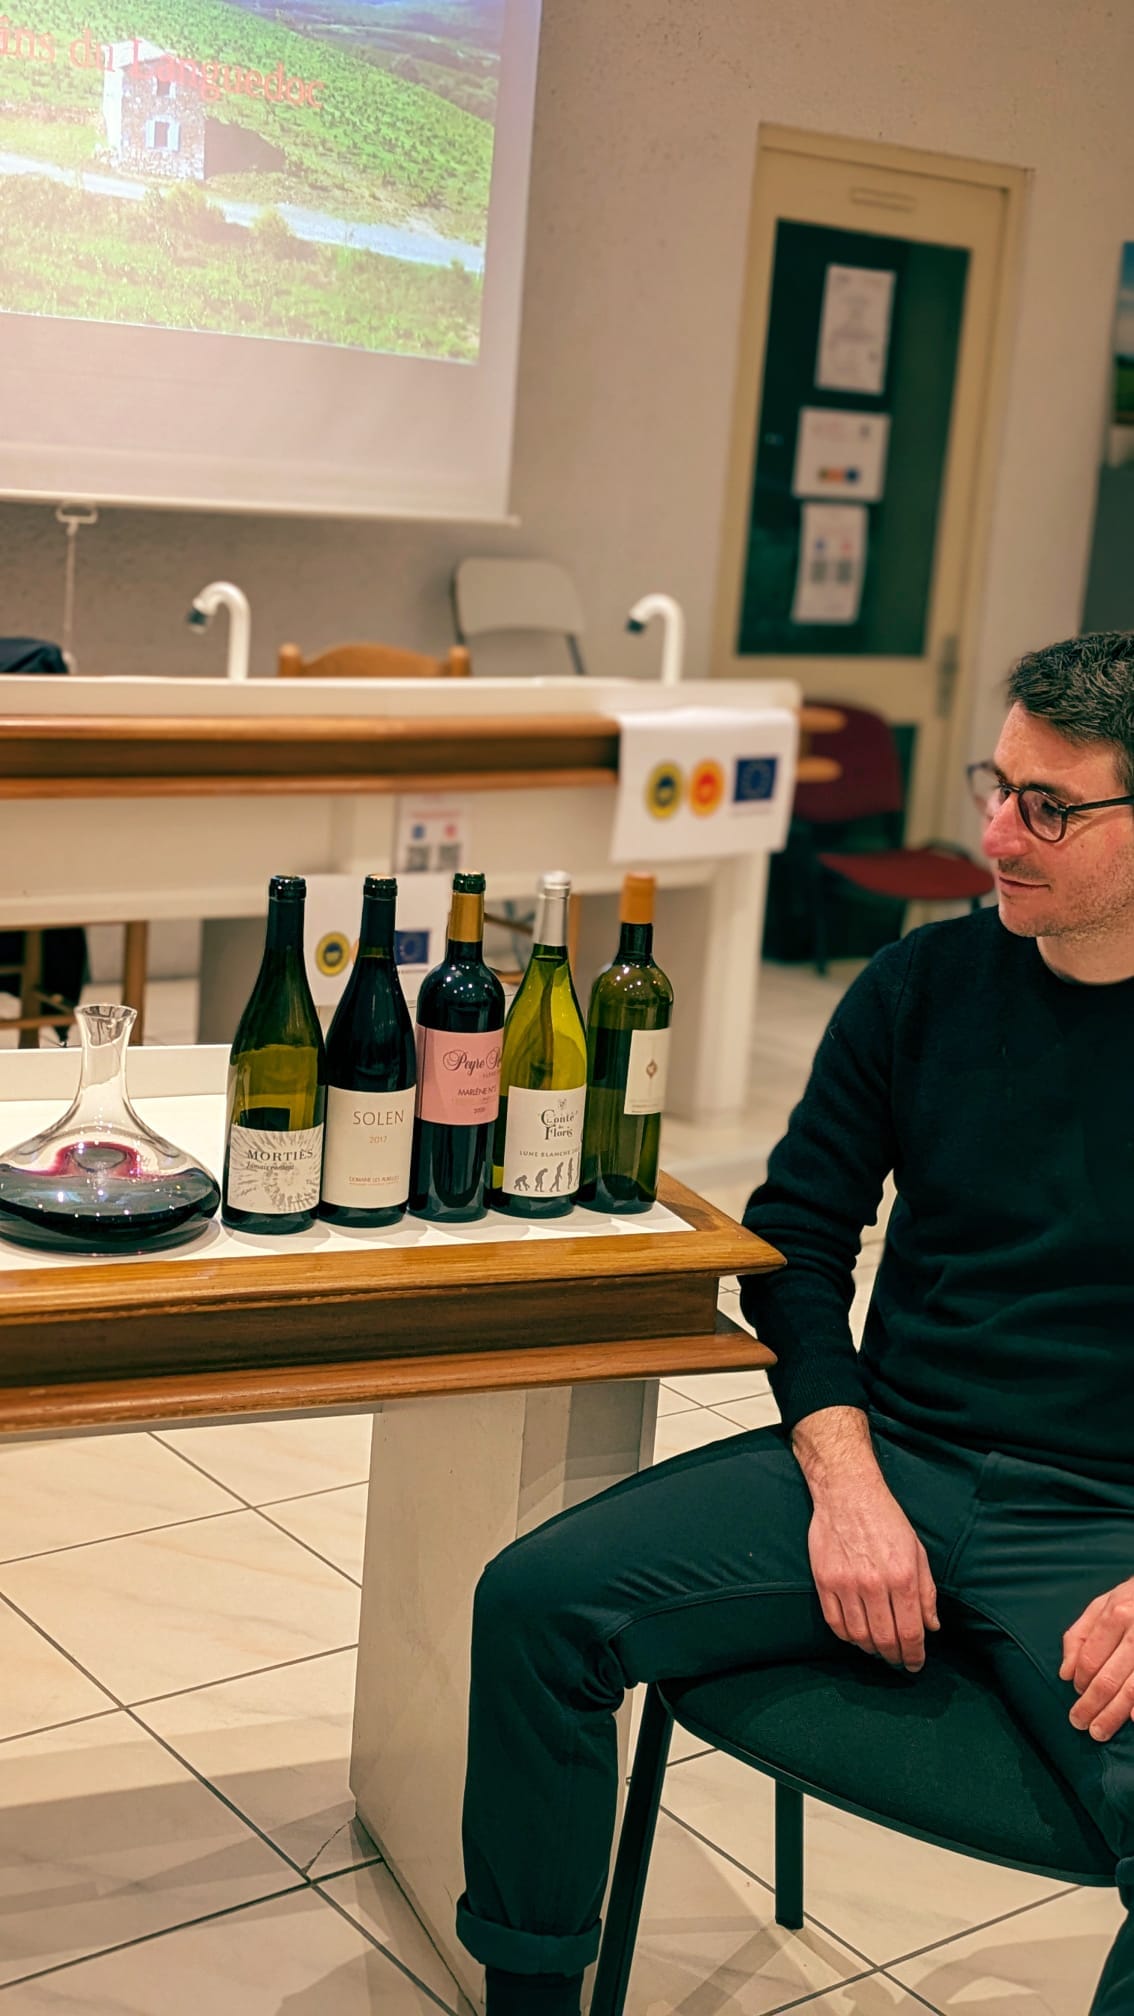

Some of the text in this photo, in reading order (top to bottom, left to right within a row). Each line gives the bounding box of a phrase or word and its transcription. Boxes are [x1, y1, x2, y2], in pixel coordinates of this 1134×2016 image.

[69, 28, 114, 72] du
[131, 37, 326, 109] Languedoc
[352, 1109, 404, 1126] SOLEN
